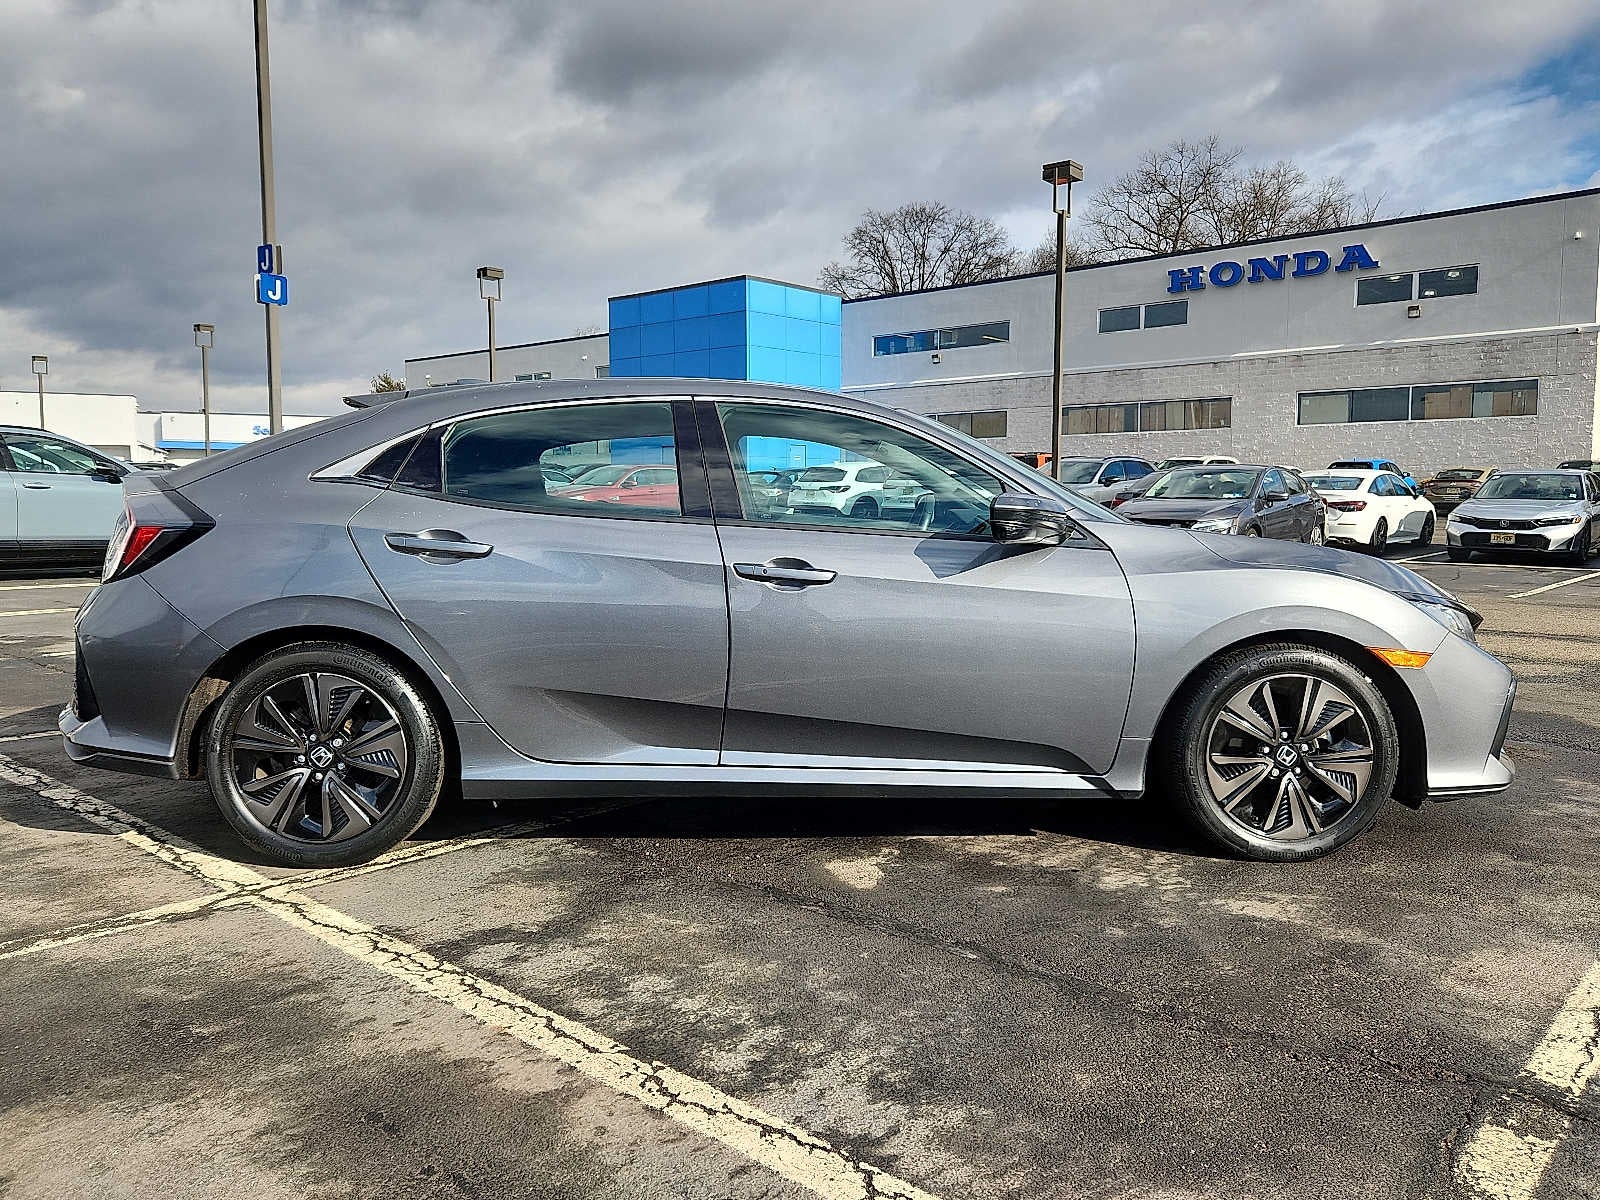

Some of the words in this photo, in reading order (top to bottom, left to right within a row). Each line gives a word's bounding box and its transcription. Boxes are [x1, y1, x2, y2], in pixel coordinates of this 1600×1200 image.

[260, 248, 269, 271] J
[1167, 244, 1380, 294] HONDA
[267, 279, 282, 301] J
